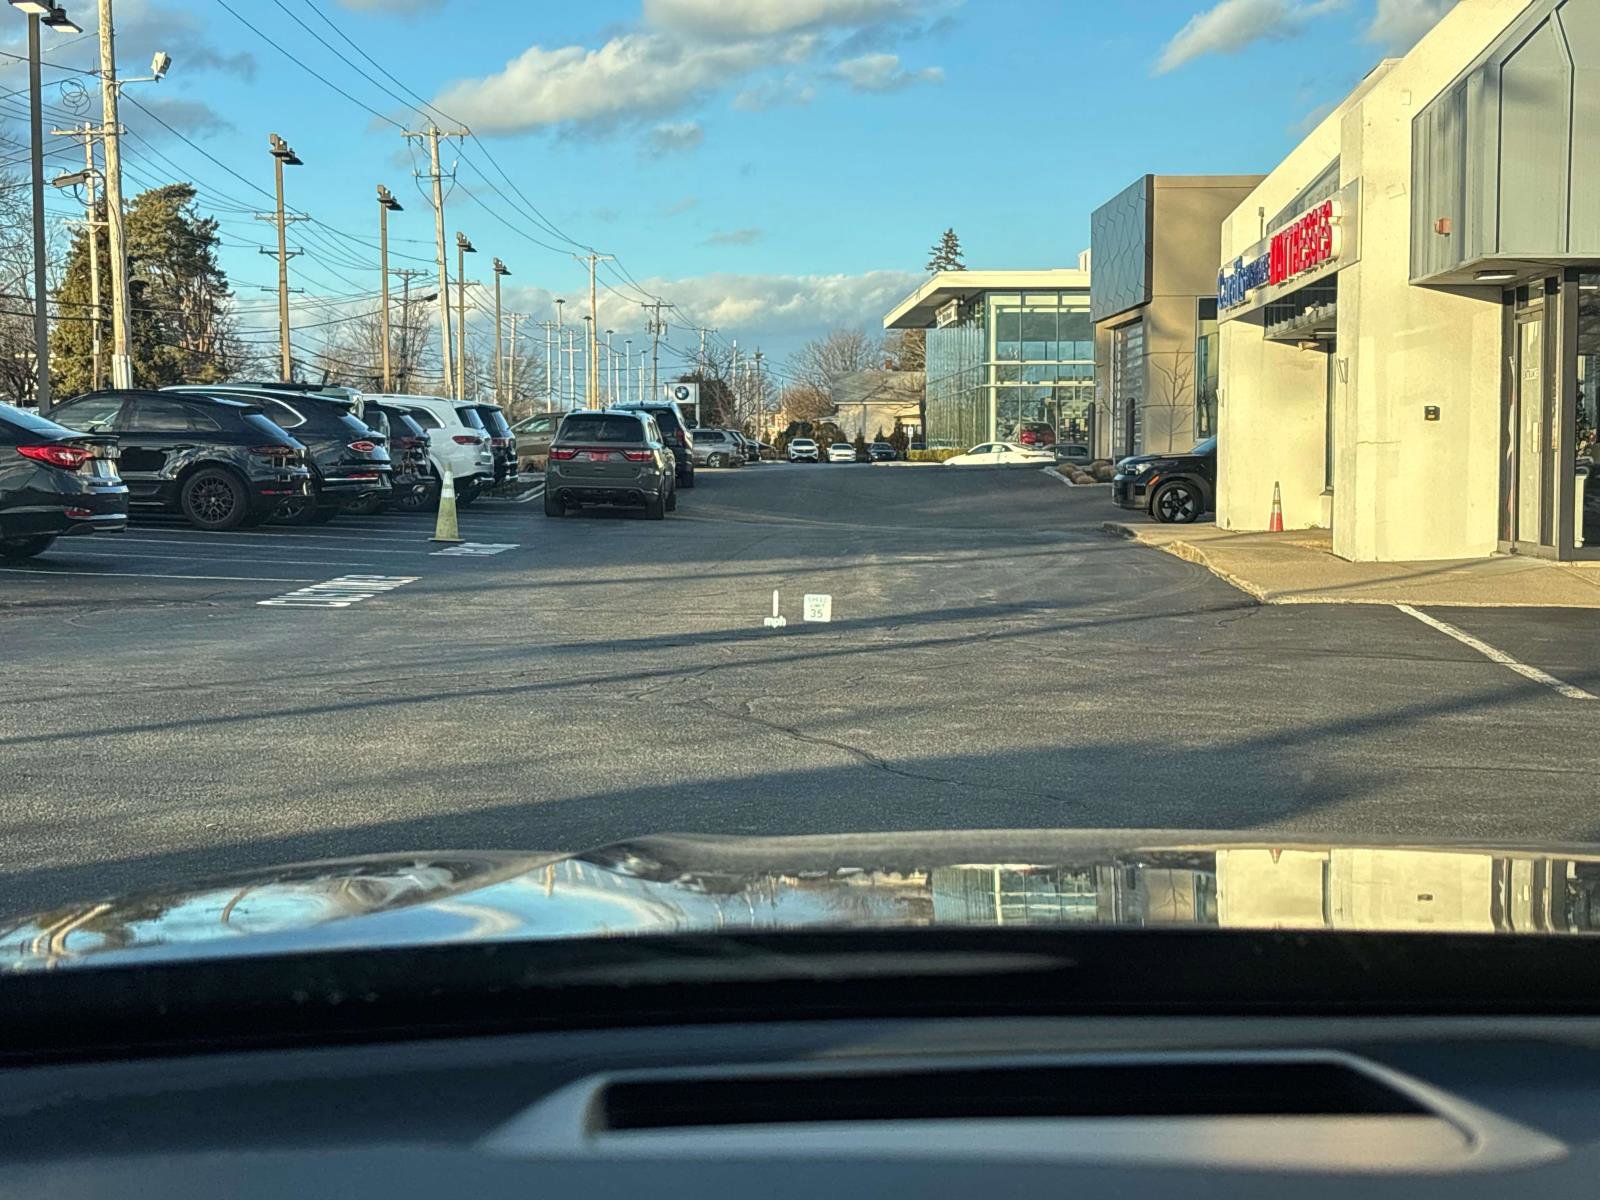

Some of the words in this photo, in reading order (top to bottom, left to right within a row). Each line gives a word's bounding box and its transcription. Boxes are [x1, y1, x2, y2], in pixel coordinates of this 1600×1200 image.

[256, 574, 423, 607] CUSTOMER
[810, 608, 823, 618] 35
[764, 615, 786, 628] mph
